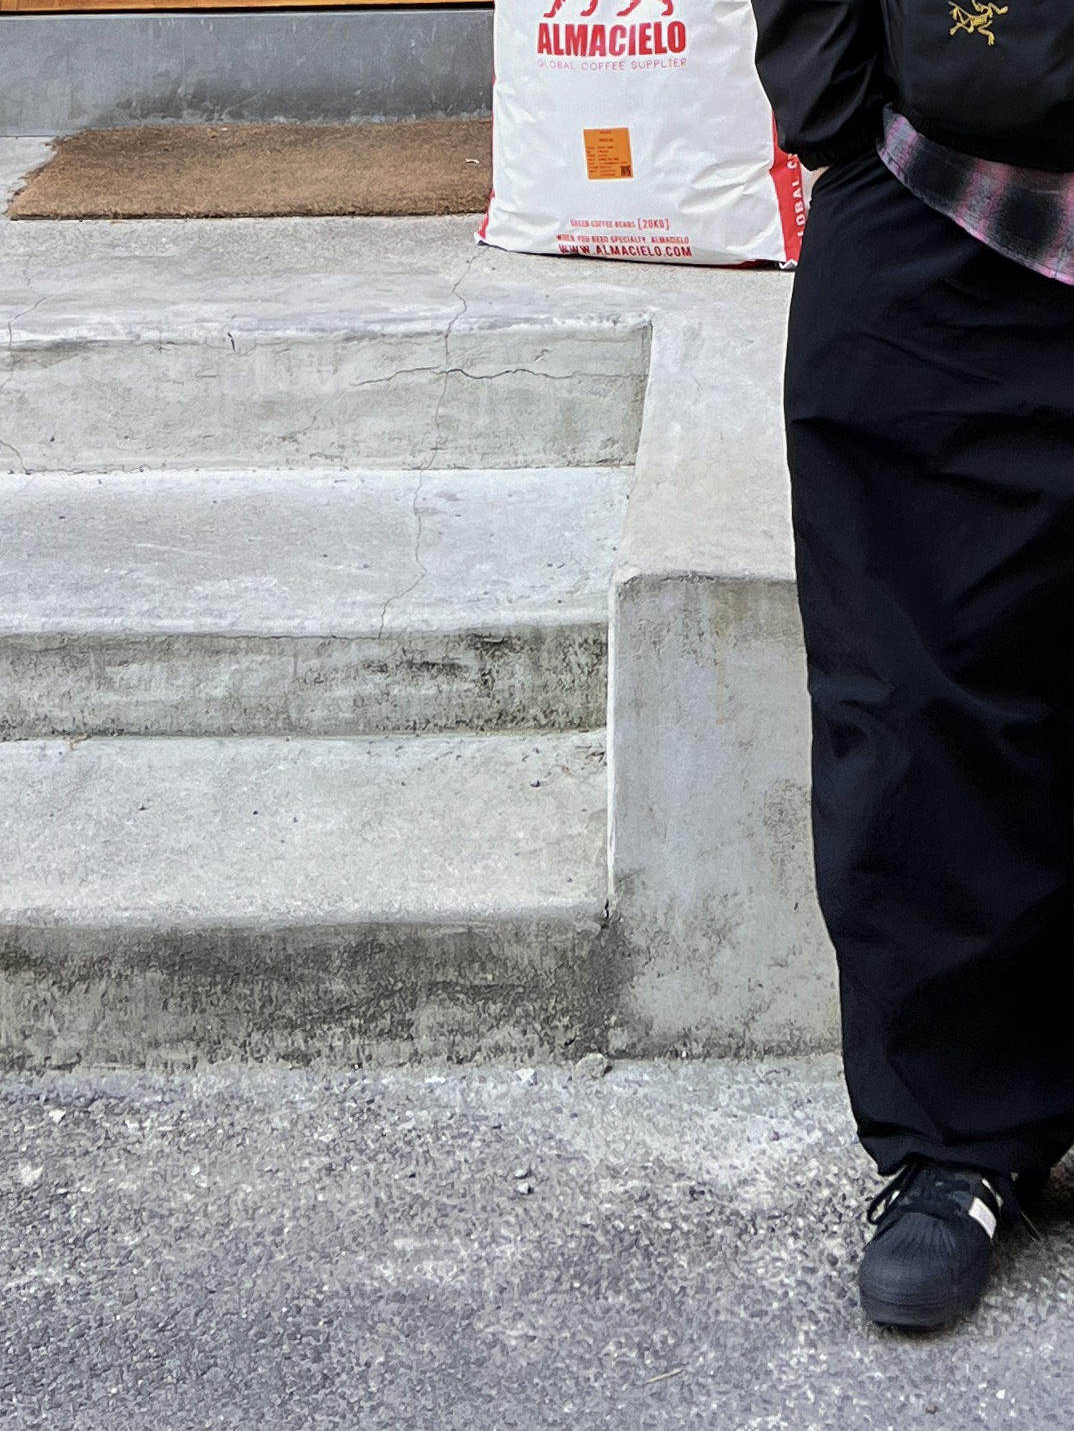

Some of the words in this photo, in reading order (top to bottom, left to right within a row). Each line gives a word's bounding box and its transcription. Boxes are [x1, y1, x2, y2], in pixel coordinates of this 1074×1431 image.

[537, 21, 686, 56] ALMACIELO
[537, 59, 575, 70] GLOBAL
[581, 60, 625, 71] COFFEE
[631, 57, 687, 69] SUPPLIER
[591, 219, 613, 228] COFFEE
[651, 236, 689, 244] ALMACIELO
